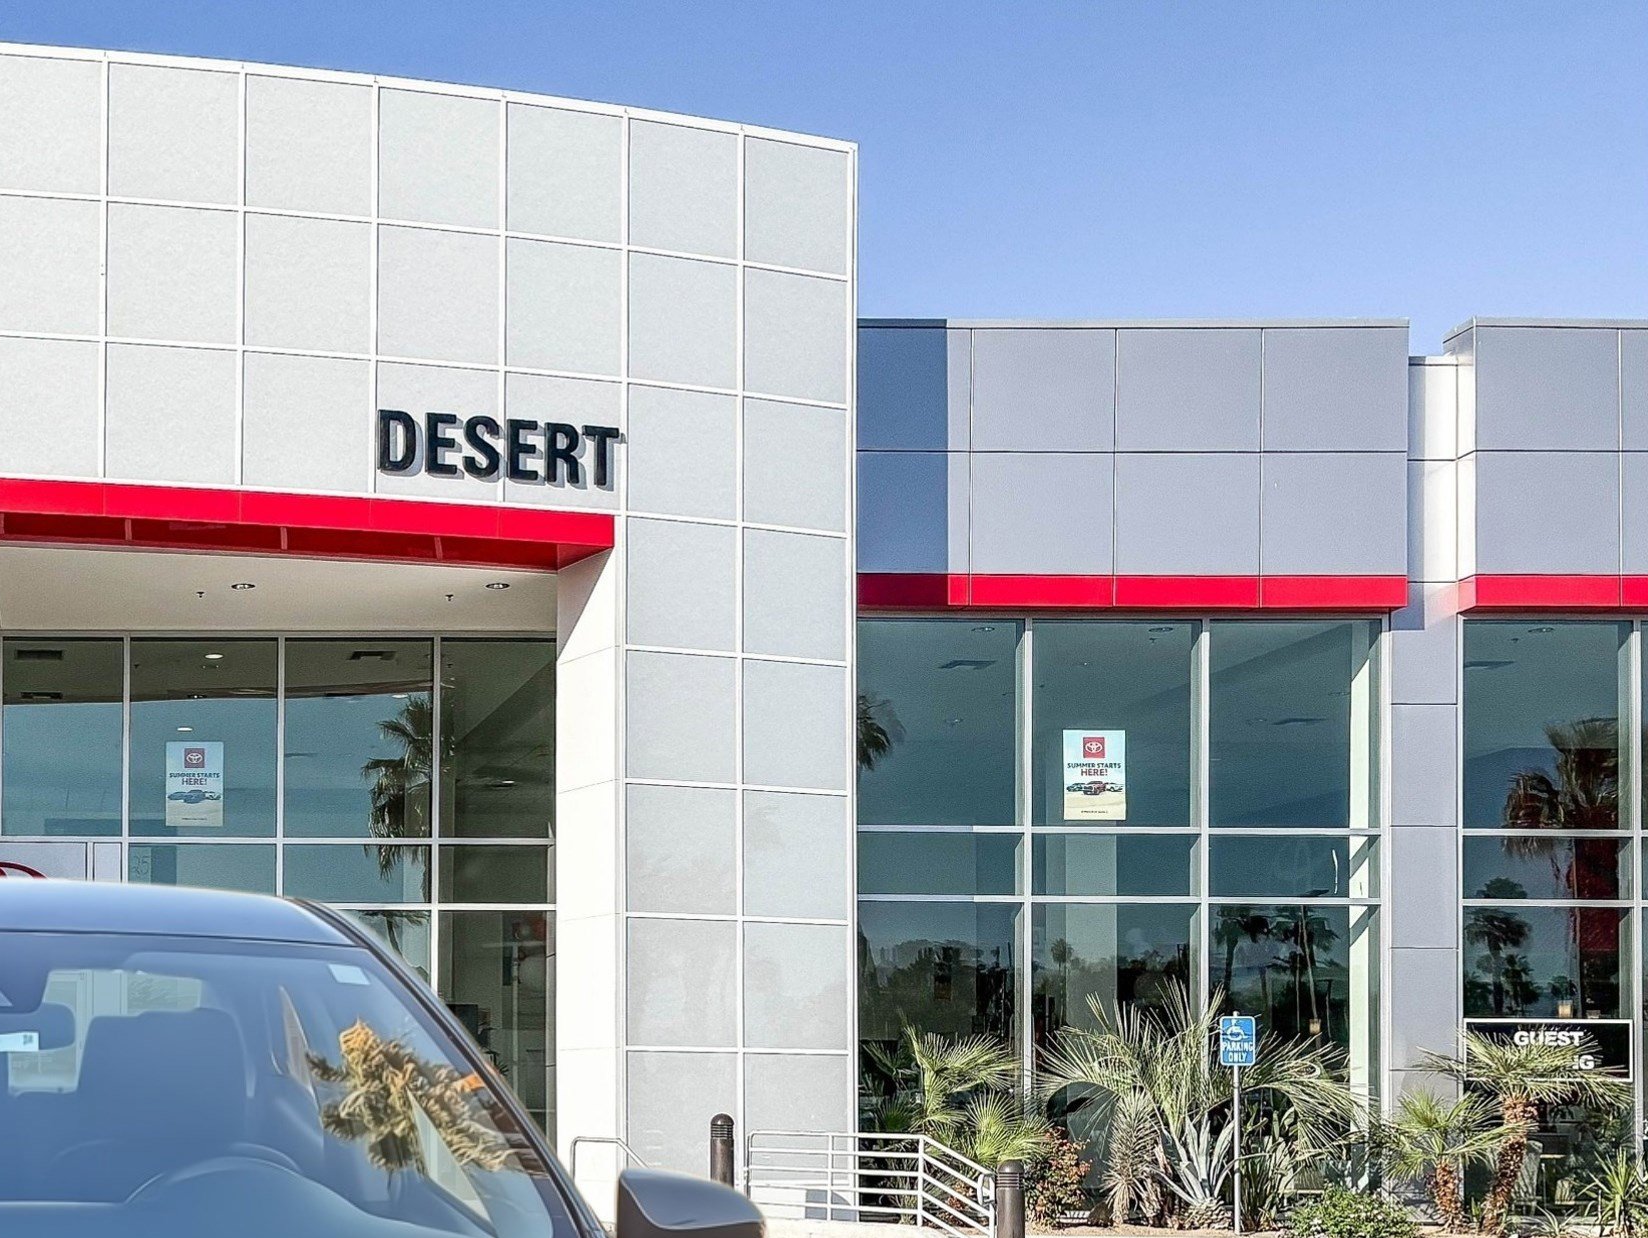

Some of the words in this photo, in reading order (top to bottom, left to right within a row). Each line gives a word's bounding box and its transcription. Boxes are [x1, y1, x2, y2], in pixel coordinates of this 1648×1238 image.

[376, 409, 620, 487] DESERT
[1080, 768, 1108, 776] HERE!
[181, 778, 208, 786] HERE!
[1513, 1030, 1584, 1047] GUEST
[1222, 1041, 1254, 1052] PARKING
[1228, 1052, 1248, 1063] ONLY
